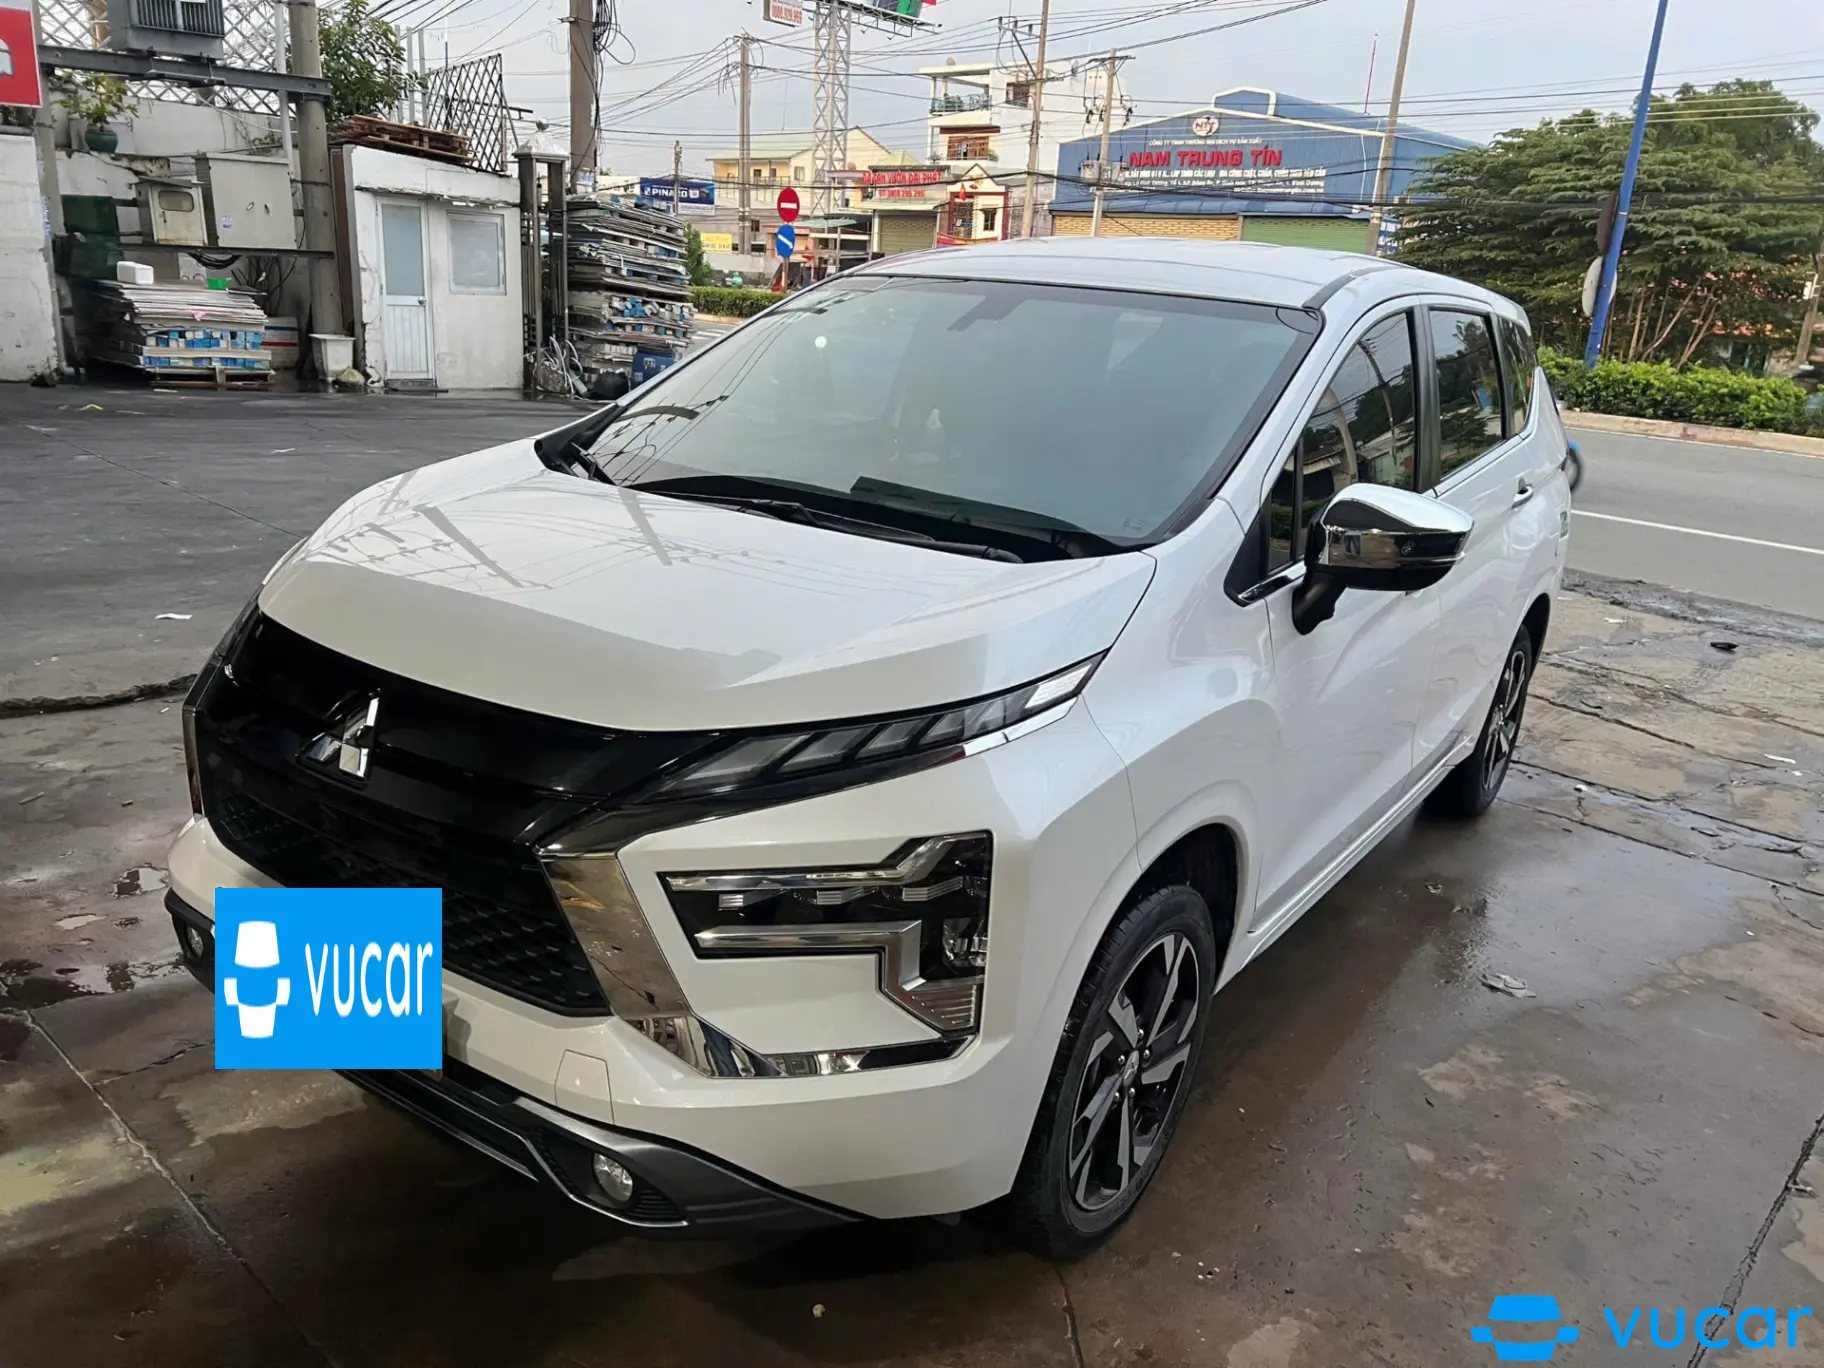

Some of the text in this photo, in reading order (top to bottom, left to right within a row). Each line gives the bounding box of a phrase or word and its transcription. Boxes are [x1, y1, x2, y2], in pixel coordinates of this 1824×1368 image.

[1129, 144, 1282, 167] NAM TRUNG TÍN
